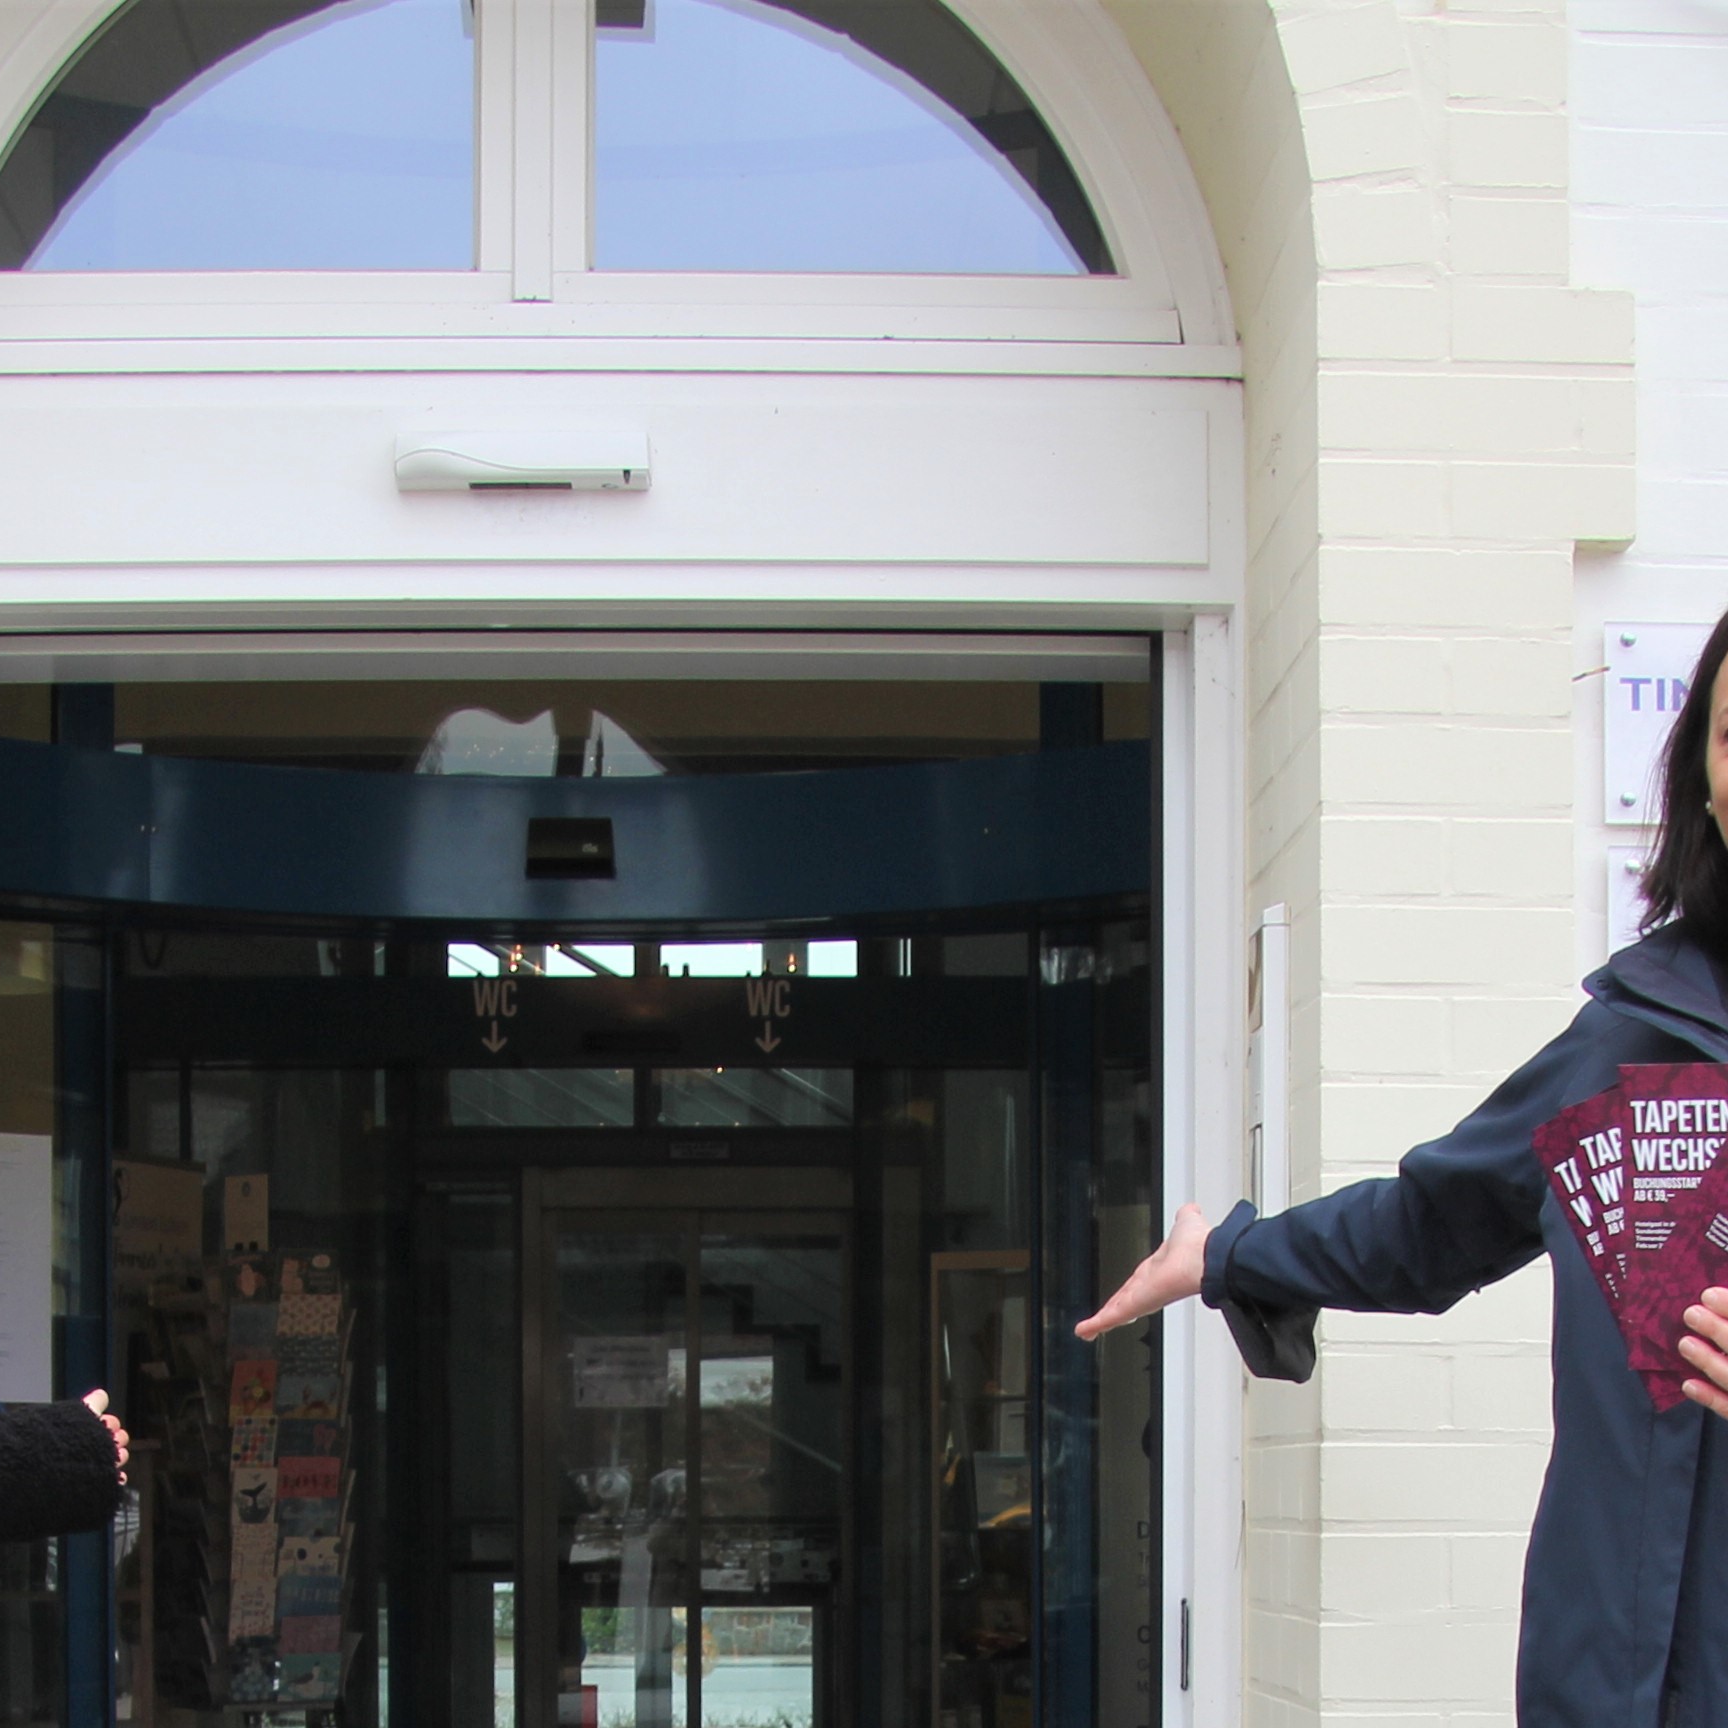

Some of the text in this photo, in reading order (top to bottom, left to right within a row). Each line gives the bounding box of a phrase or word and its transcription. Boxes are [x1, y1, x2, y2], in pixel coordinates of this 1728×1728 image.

[473, 981, 517, 1017] WC
[746, 981, 790, 1017] WC
[1631, 1137, 1727, 1172] WECHS
[1633, 1190, 1646, 1202] AB
